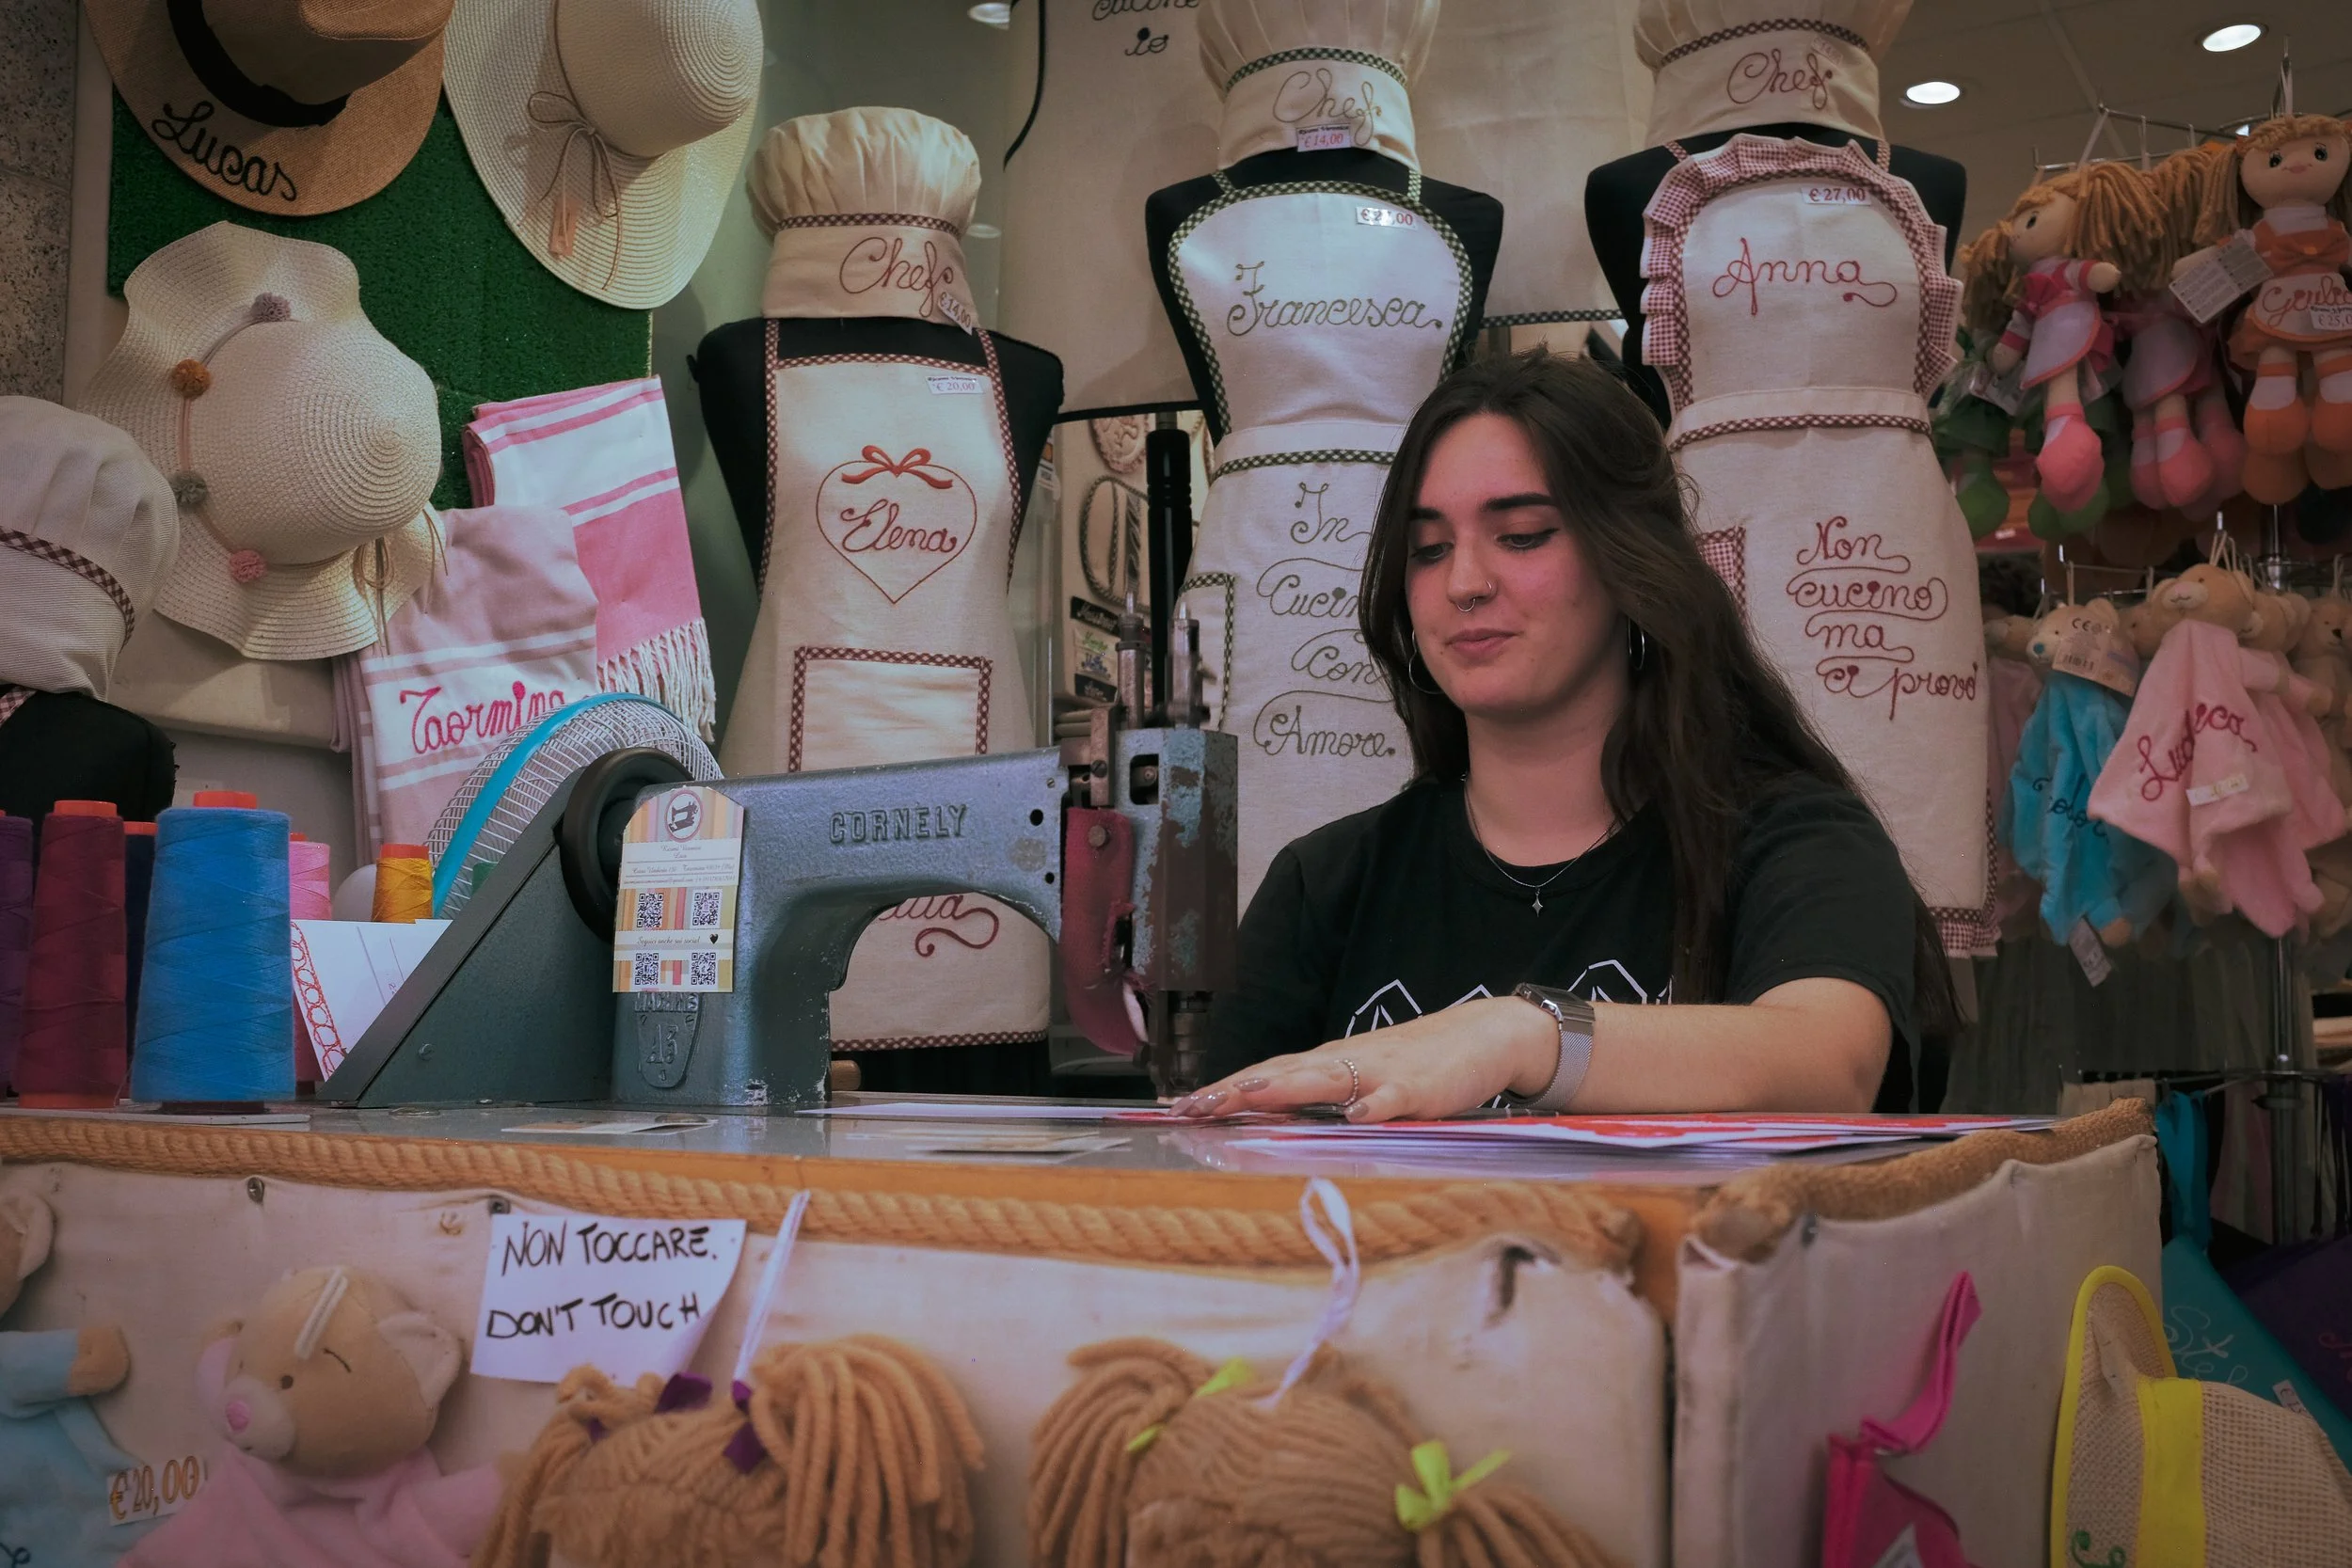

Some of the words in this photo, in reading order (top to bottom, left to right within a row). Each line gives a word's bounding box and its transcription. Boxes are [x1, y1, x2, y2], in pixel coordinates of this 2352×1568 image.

[1272, 68, 1383, 147] Chef
[1728, 49, 1833, 110] Chef
[151, 100, 297, 202] Lucas
[839, 236, 954, 318] Chef
[1226, 261, 1443, 337] Francesca
[1712, 237, 1898, 316] Anna
[840, 499, 957, 553] Elena
[1797, 515, 1910, 566] Non
[1806, 623, 1899, 651] ma
[830, 803, 967, 844] CORNELY
[501, 1221, 567, 1275] NON
[485, 1298, 583, 1339] DON'T
[590, 1292, 701, 1330] TOUCH
